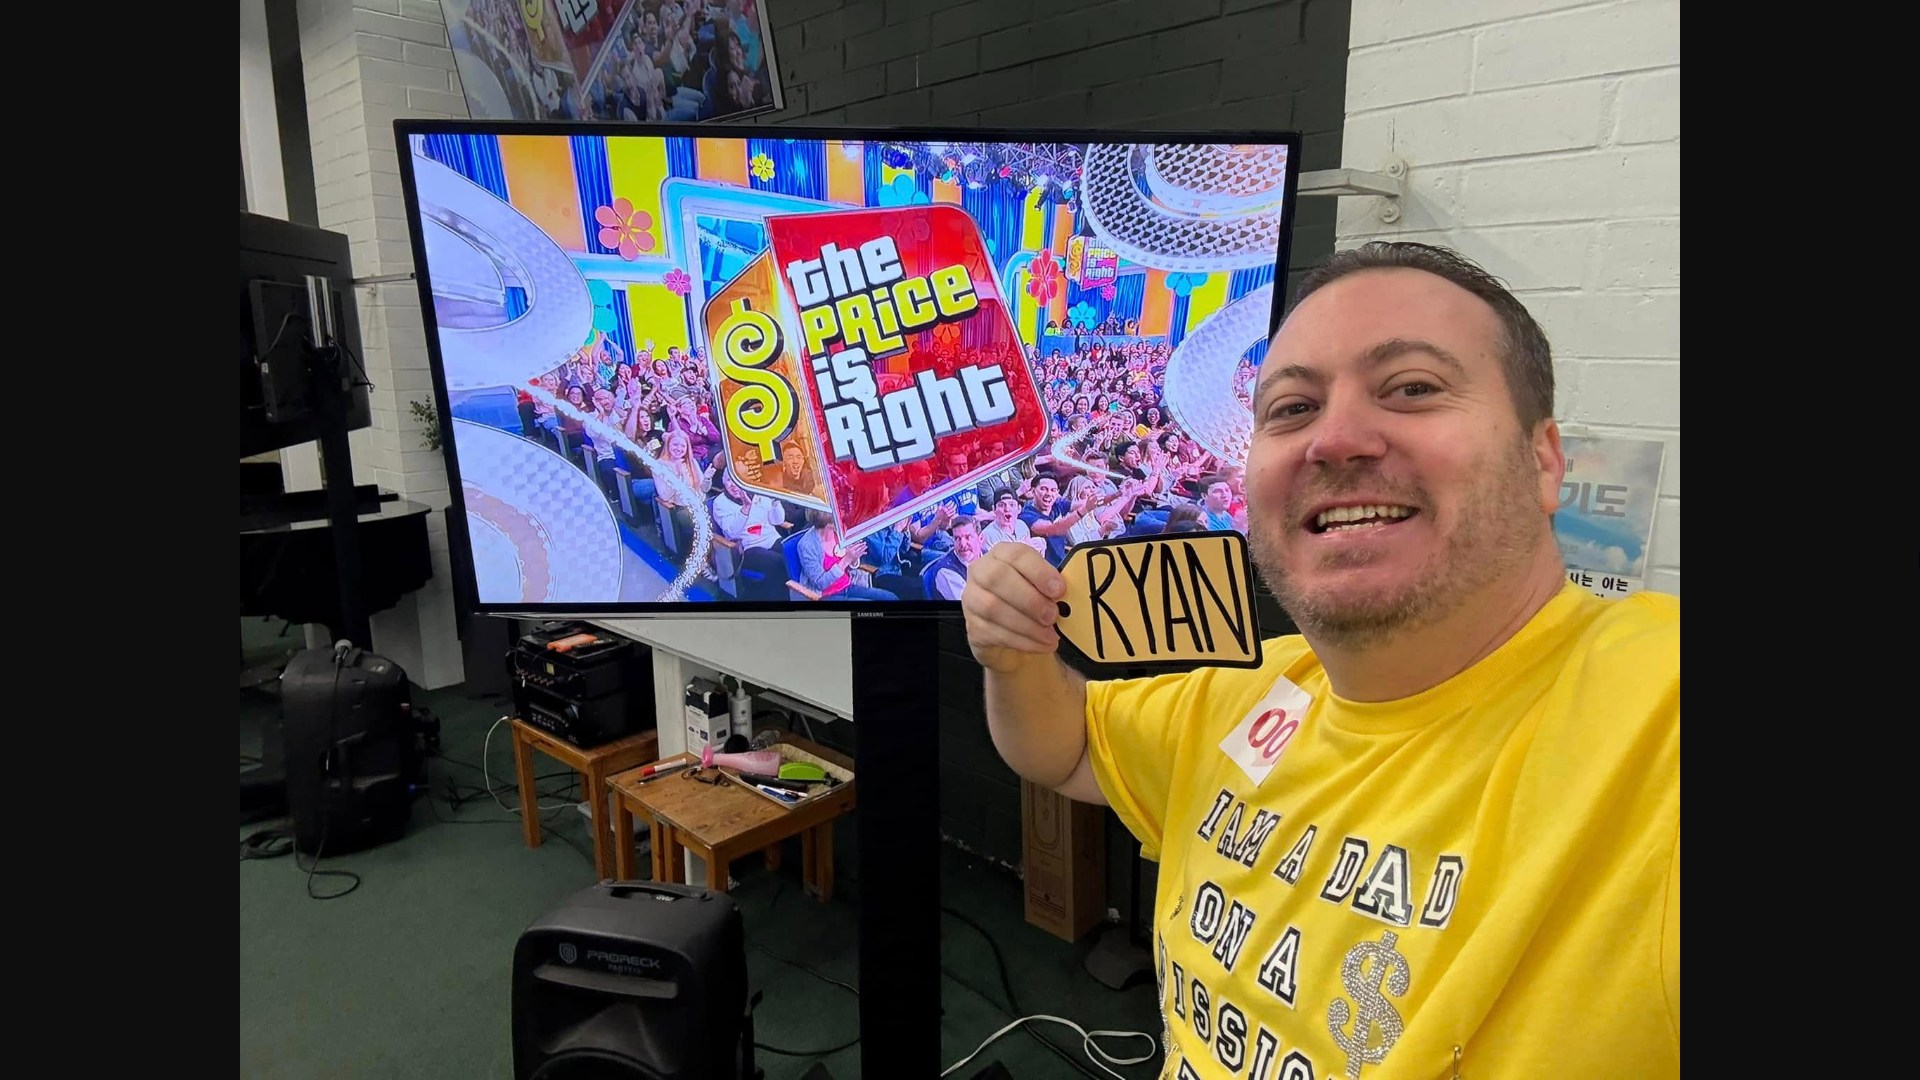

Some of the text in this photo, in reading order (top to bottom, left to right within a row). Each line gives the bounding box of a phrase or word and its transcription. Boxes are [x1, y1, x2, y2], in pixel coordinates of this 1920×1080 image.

[787, 236, 903, 307] the
[811, 348, 877, 407] is
[824, 364, 1016, 471] Right
[1086, 538, 1250, 660] RYAN
[1601, 576, 1628, 592] 이는
[1198, 789, 1464, 927] I AM A DAD
[586, 950, 661, 969] PRORECK
[1191, 881, 1301, 1004] ON A
